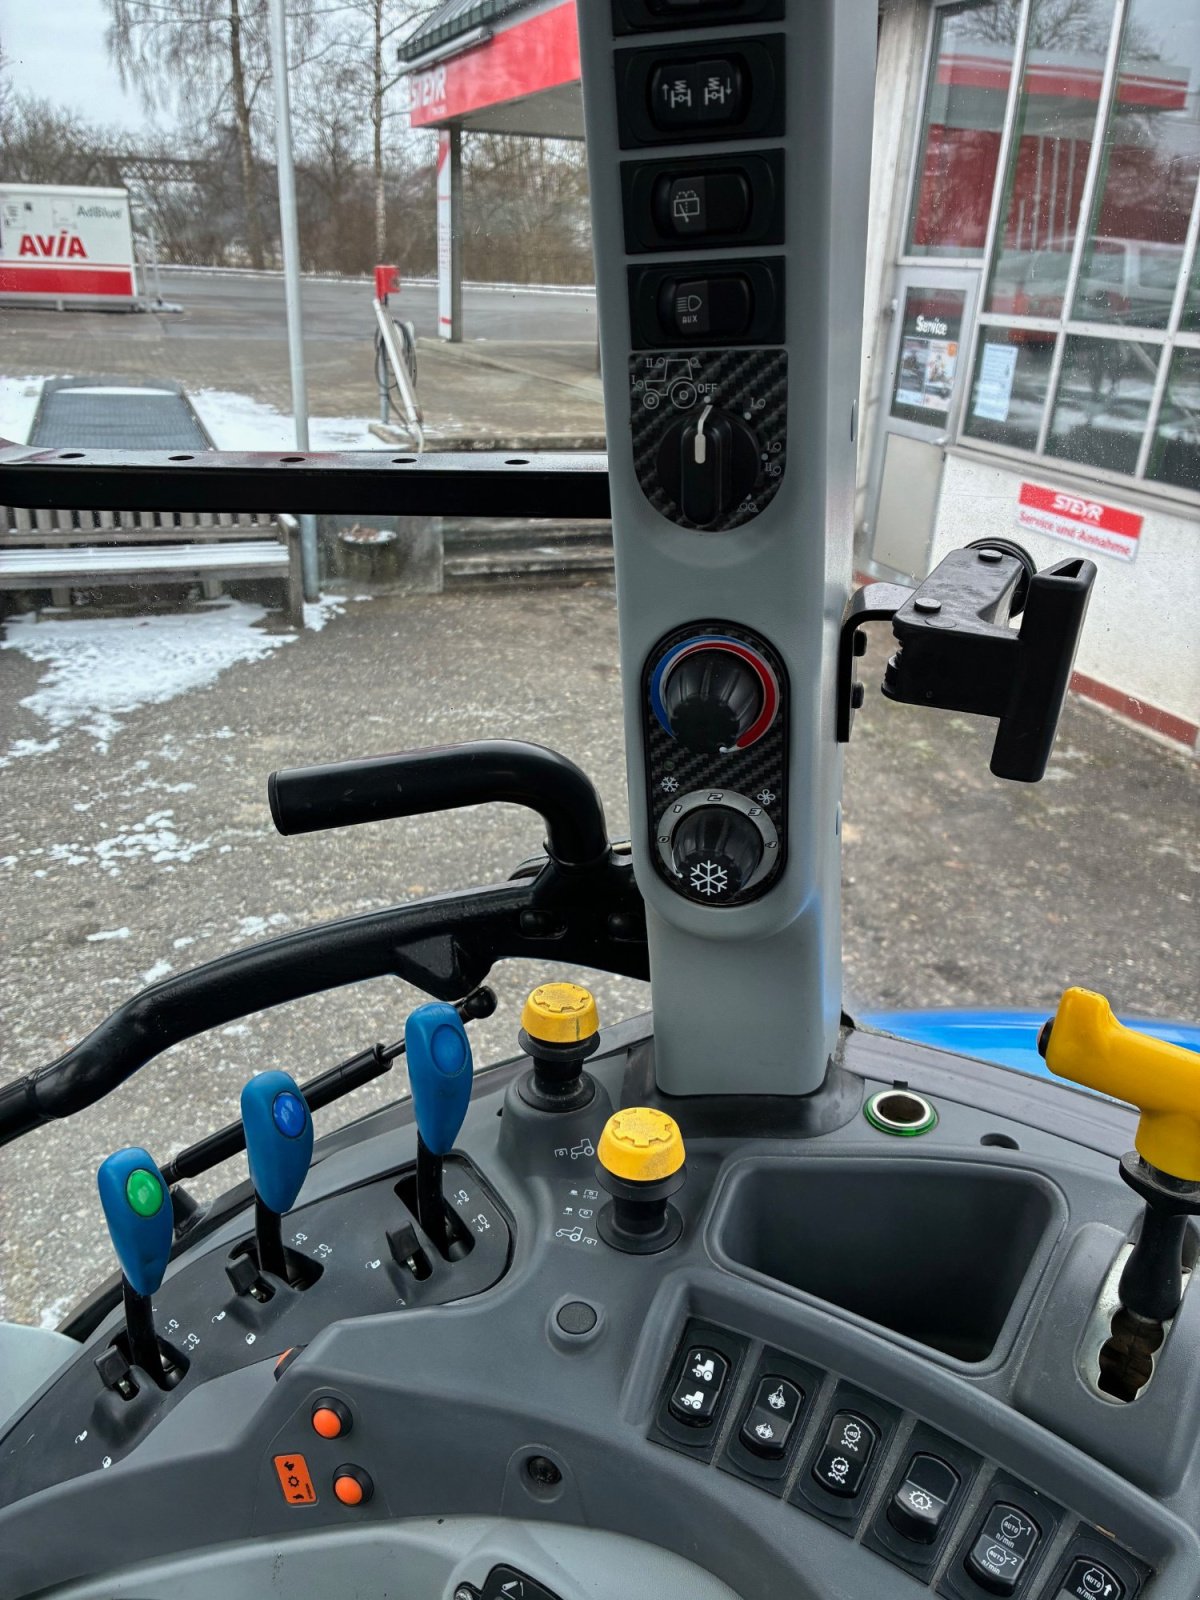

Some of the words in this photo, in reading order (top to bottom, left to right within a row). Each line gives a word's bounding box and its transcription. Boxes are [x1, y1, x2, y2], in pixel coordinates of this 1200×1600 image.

[77, 205, 122, 219] AdBlue
[682, 314, 698, 324] AUX
[915, 314, 948, 336] Service
[697, 383, 718, 394] OFF
[707, 792, 724, 801] 2
[673, 804, 683, 813] 1
[748, 807, 763, 816] 3
[694, 1353, 702, 1362] A
[1003, 1520, 1019, 1534] AUTO
[995, 1532, 1015, 1549] n/min
[989, 1550, 1004, 1563] AUTO
[981, 1559, 1001, 1575] n/min
[1085, 1574, 1102, 1589] AUTO
